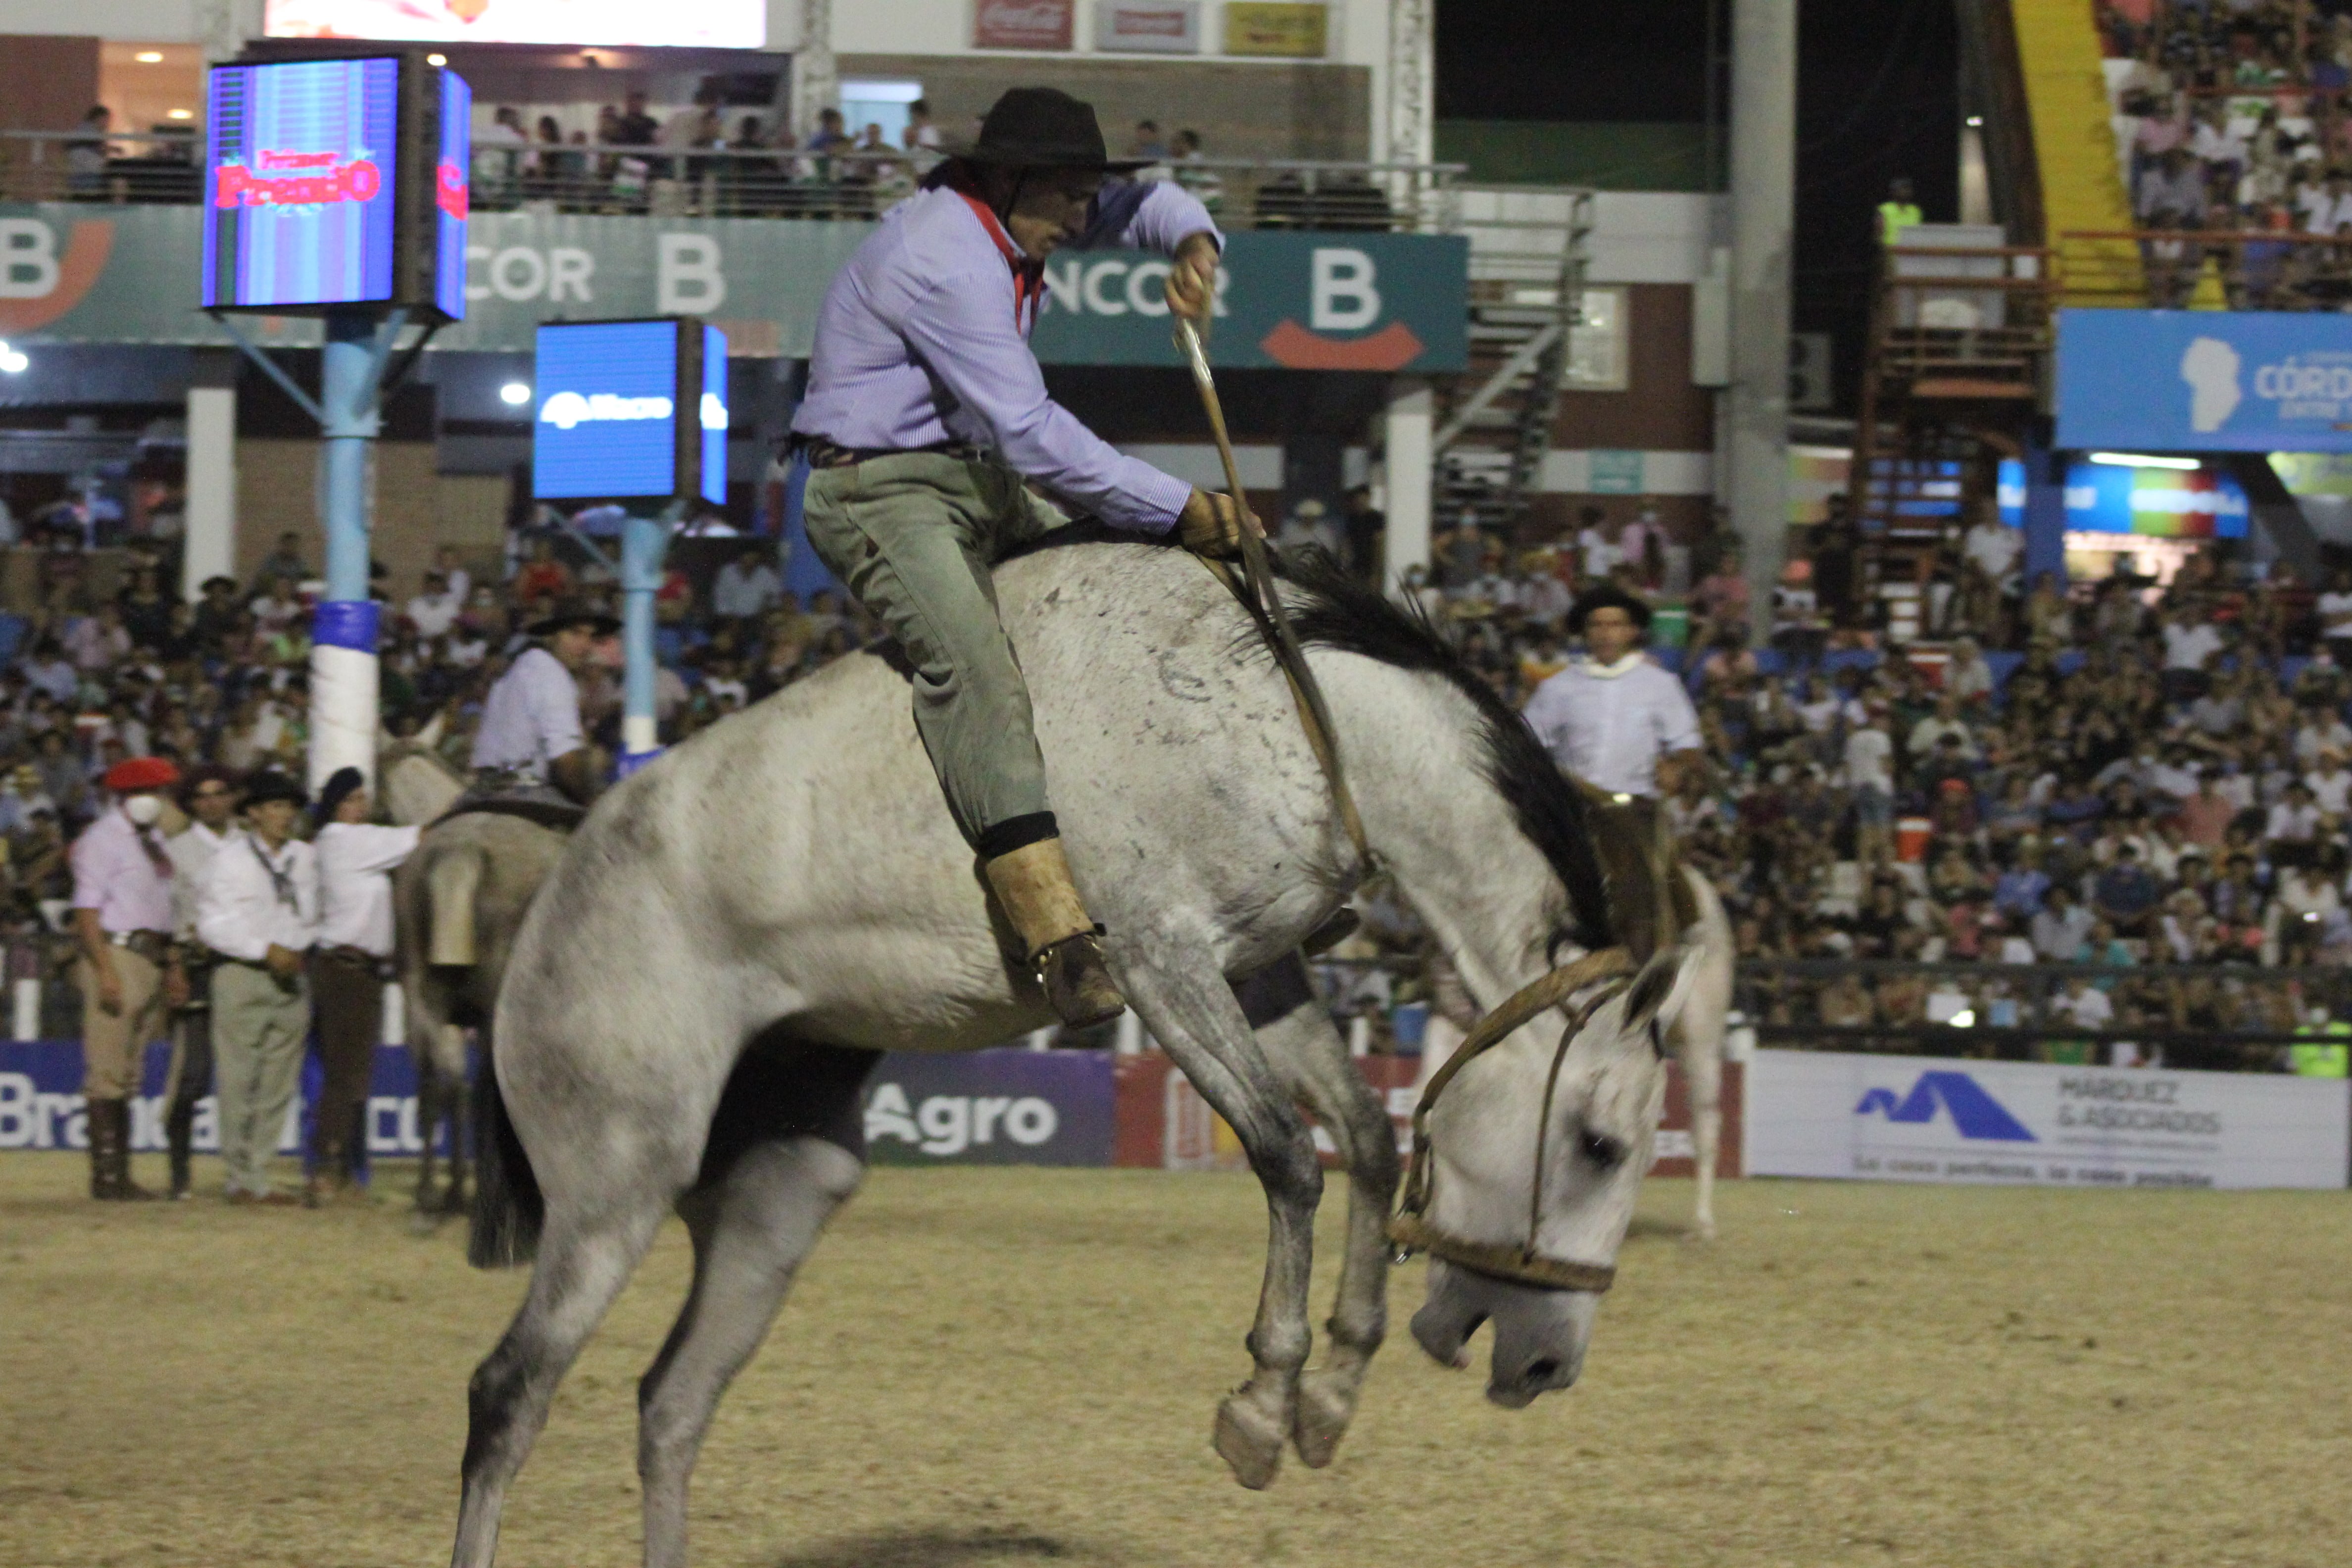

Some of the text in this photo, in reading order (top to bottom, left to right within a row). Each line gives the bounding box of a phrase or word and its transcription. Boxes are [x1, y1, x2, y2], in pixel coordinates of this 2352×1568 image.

[0, 218, 60, 297] B
[656, 233, 728, 314] B
[1311, 248, 1381, 330] B
[863, 1083, 1057, 1155] Agro
